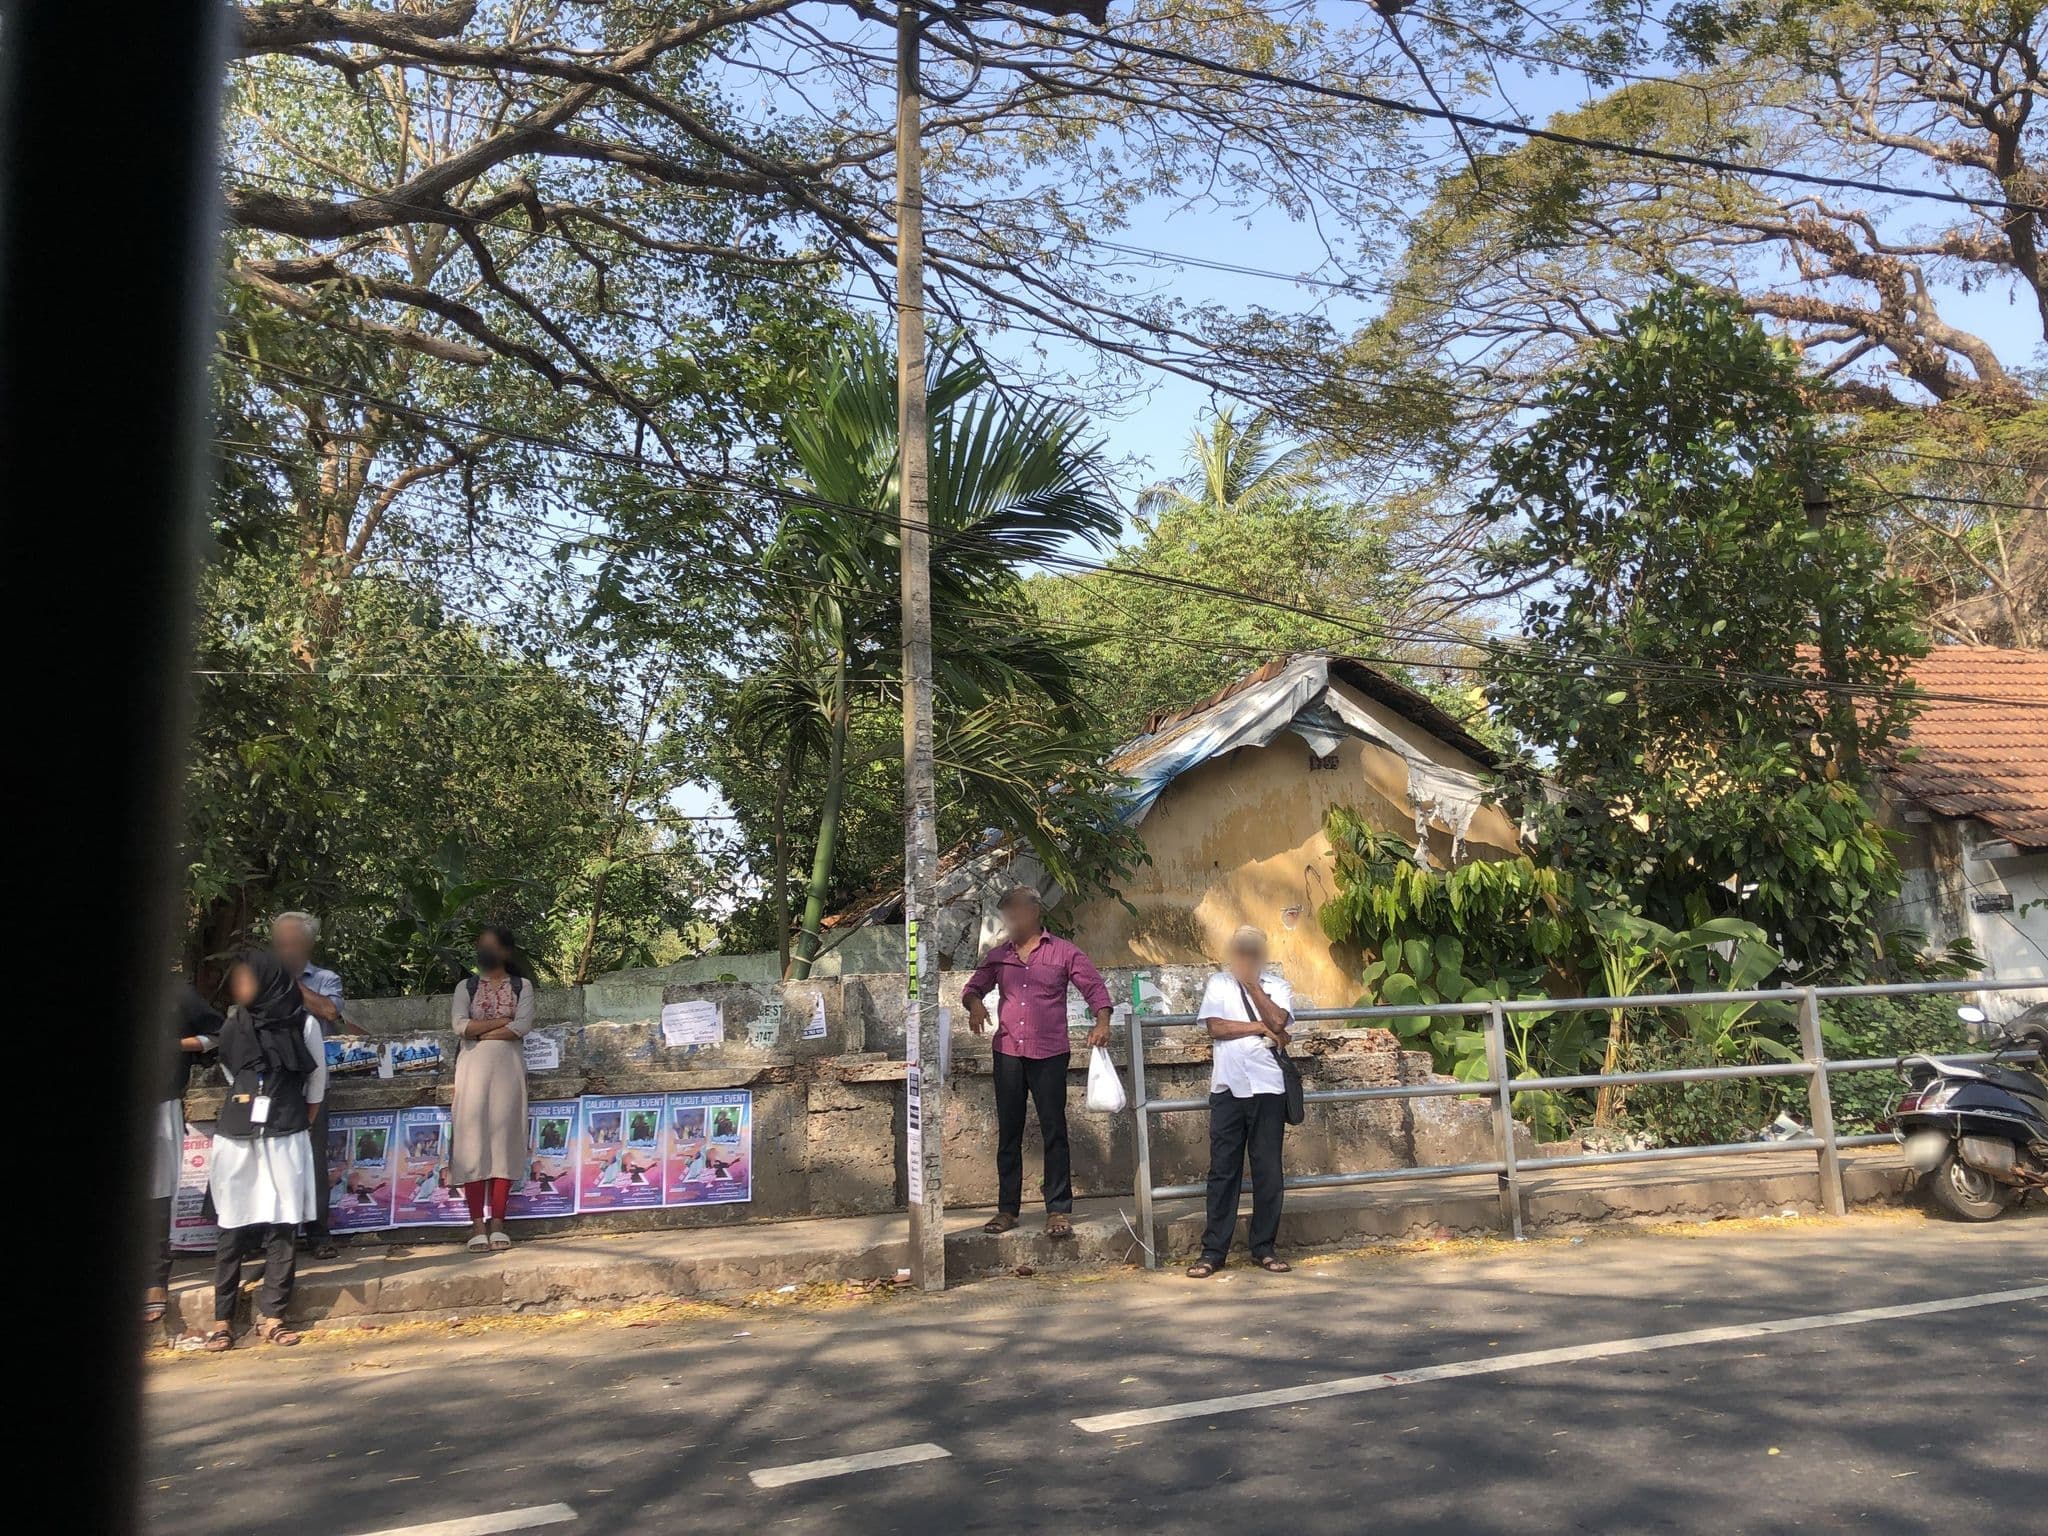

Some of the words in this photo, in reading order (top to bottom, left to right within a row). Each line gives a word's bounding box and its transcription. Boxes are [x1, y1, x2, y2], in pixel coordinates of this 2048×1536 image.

[585, 1100, 617, 1109] CALICUT
[618, 1099, 640, 1108] MUSIC
[640, 1098, 664, 1107] EVENT
[670, 1096, 699, 1106] CALICUT
[701, 1095, 723, 1105] MUSIC
[724, 1094, 747, 1103] EVENT
[552, 1105, 576, 1115] EVENT
[343, 1116, 368, 1127] MUSIC
[369, 1114, 394, 1125] EVENT
[402, 1112, 434, 1121] CALICUT
[436, 1111, 452, 1121] MUS
